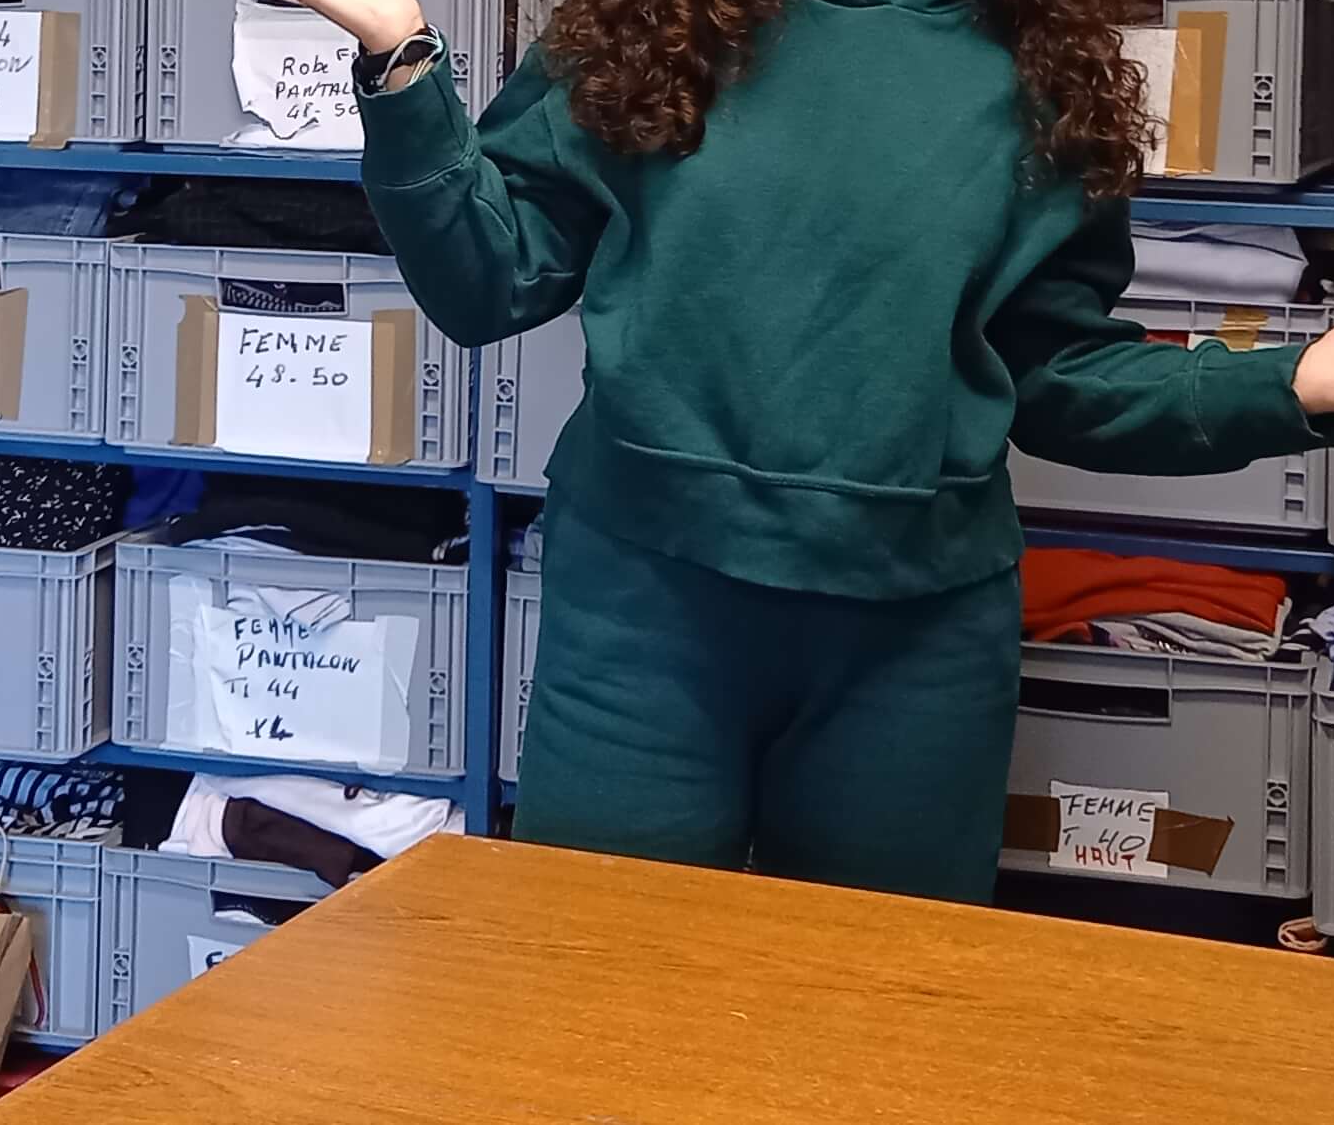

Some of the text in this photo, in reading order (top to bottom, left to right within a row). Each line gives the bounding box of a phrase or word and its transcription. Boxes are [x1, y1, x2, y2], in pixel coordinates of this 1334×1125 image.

[282, 55, 329, 75] Robe
[239, 328, 348, 355] FEMME
[234, 617, 310, 648] FEMME
[236, 642, 361, 674] PANTALON
[267, 678, 299, 700] 44
[1060, 794, 1156, 823] FEMME
[1062, 826, 1146, 853] T 40
[1075, 844, 1136, 872] HAUT
